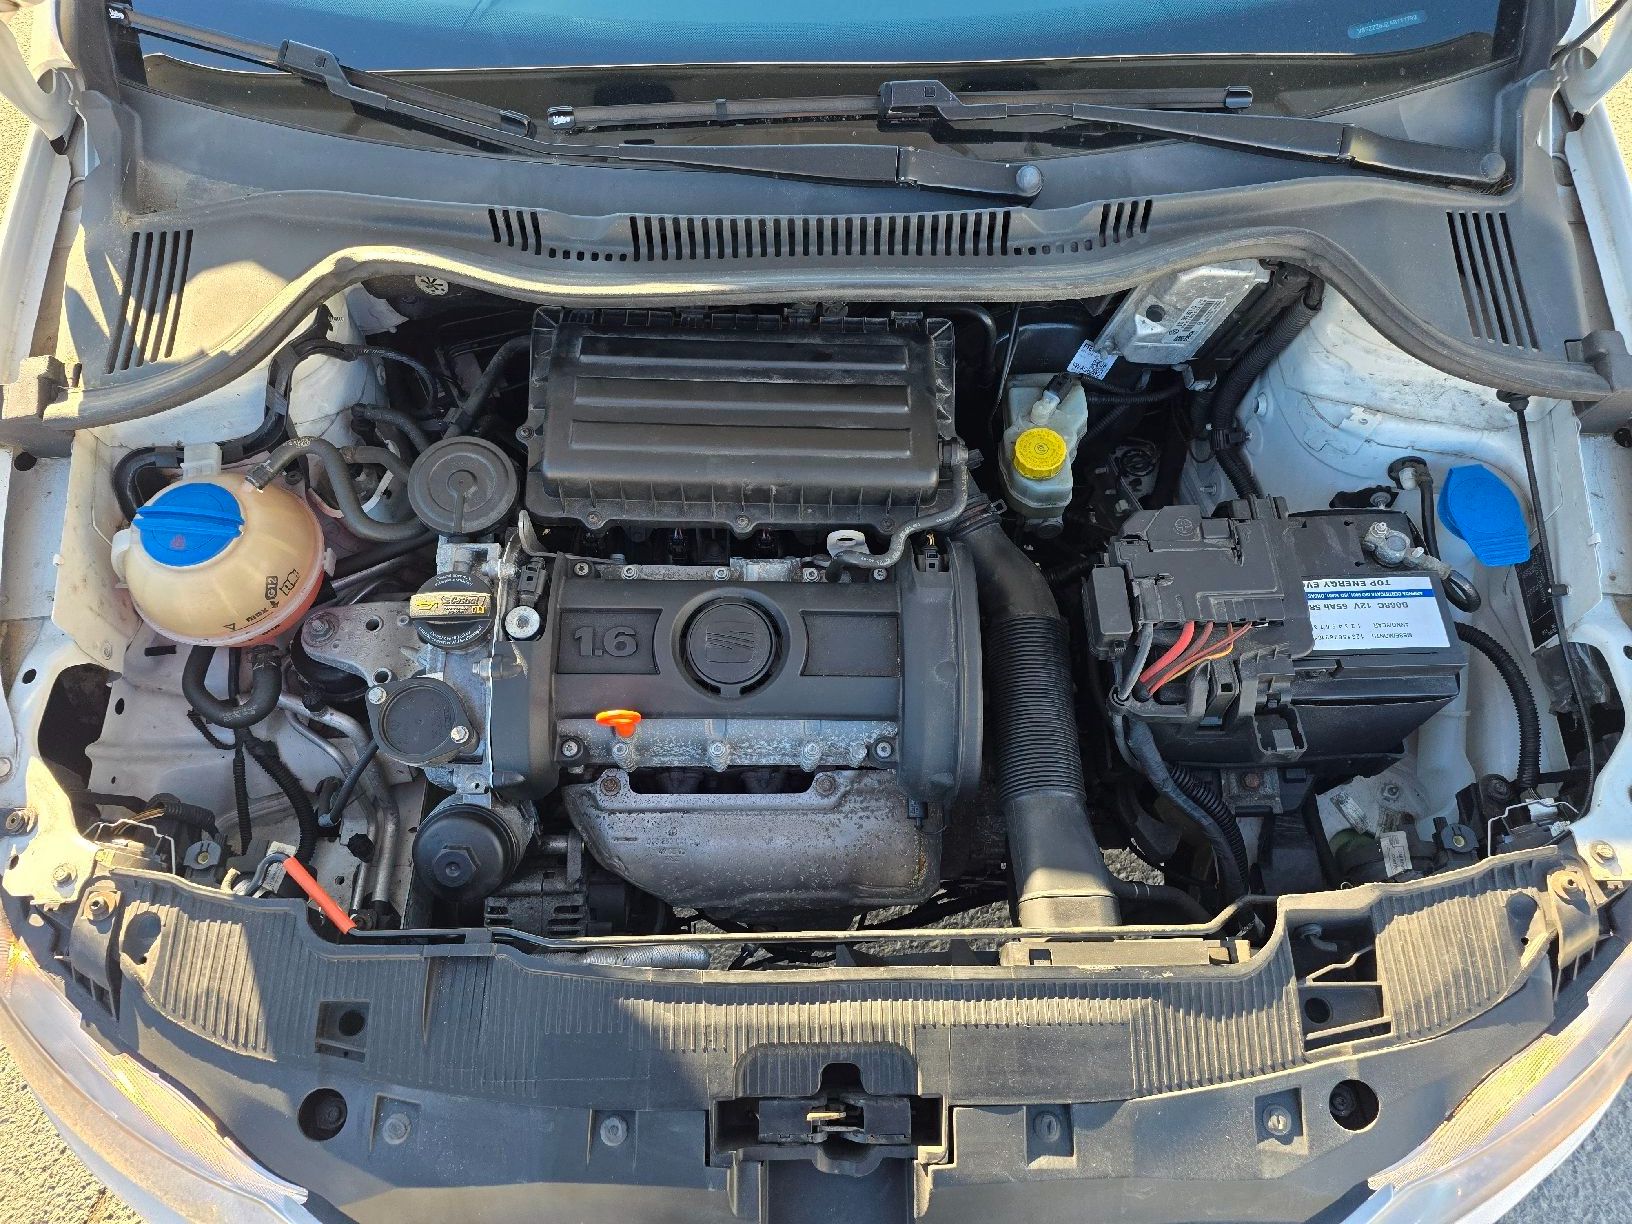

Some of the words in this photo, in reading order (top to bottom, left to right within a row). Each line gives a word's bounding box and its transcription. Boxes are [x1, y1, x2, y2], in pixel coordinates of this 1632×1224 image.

[1323, 580, 1366, 588] ENERGY
[1370, 579, 1391, 587] TOP
[1323, 603, 1348, 611] 65Ah
[1354, 602, 1372, 610] 12V
[574, 626, 638, 657] 1.6
